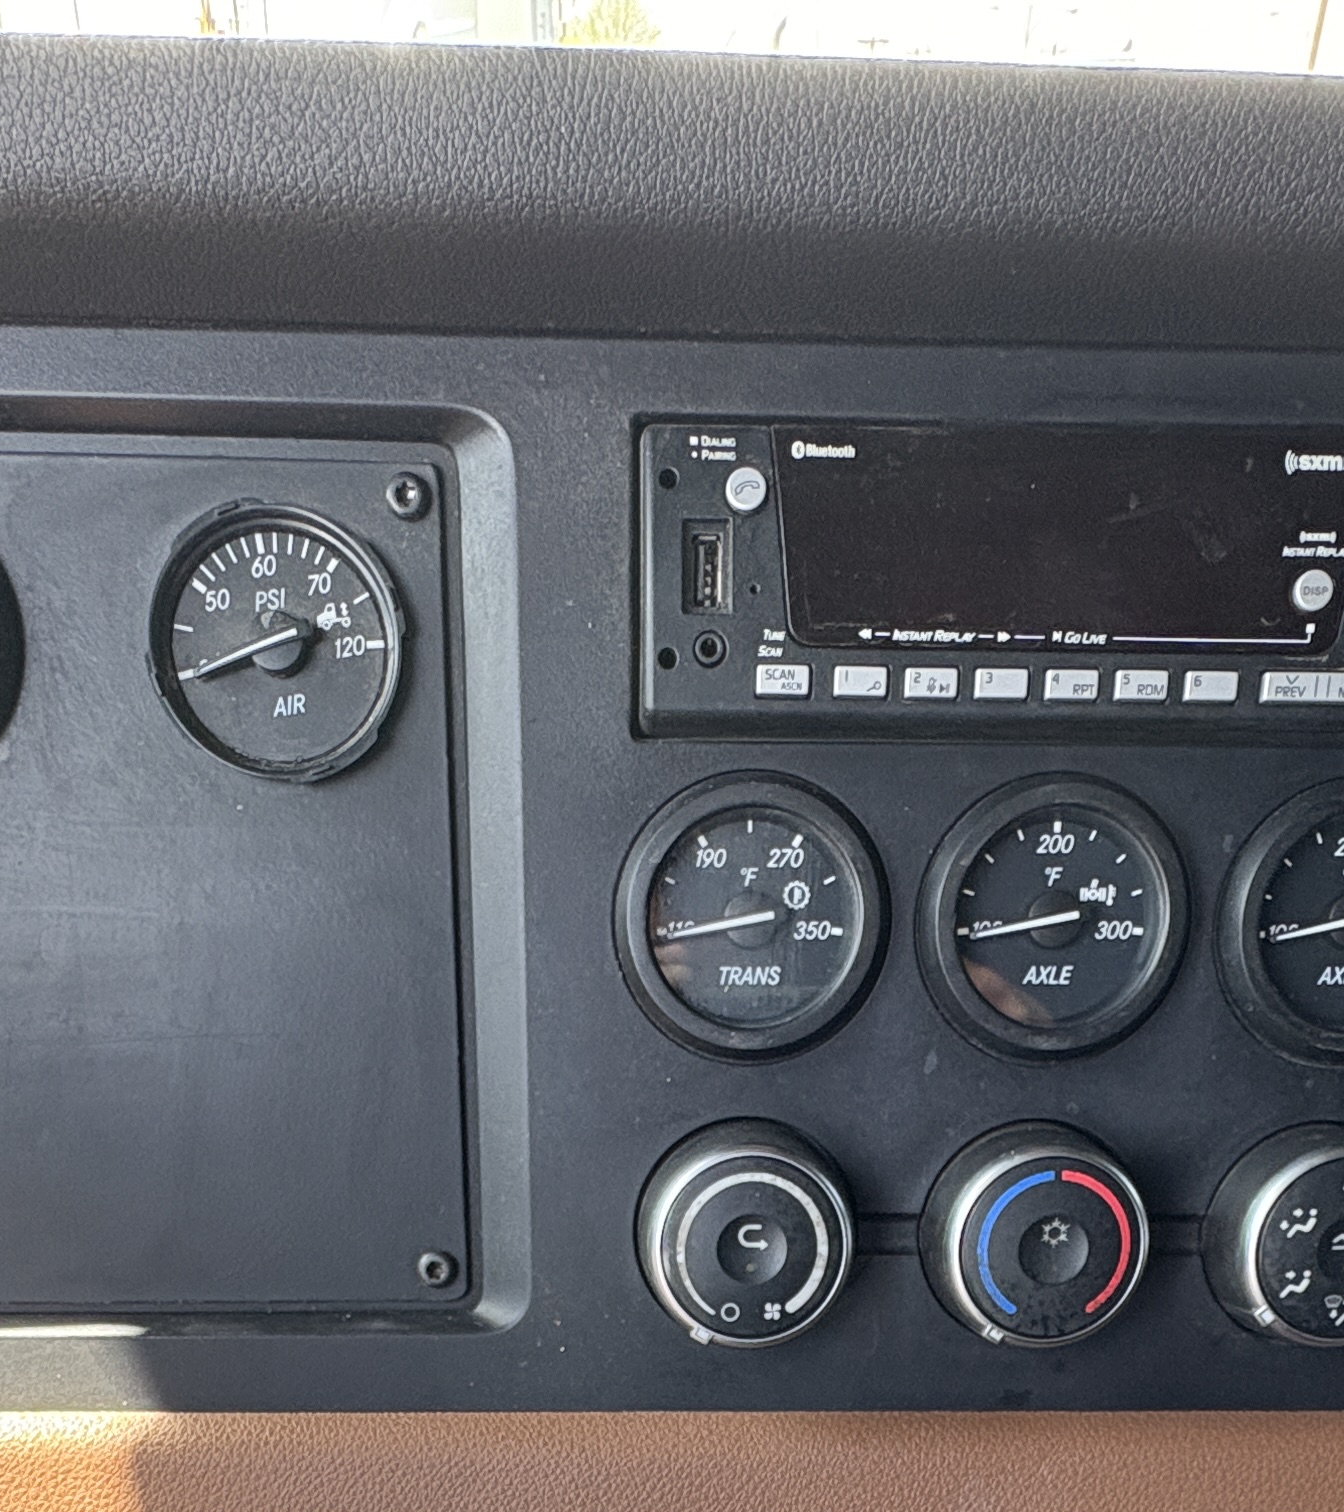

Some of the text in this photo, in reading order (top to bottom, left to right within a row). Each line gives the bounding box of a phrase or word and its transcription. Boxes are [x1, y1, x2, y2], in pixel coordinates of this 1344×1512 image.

[805, 443, 856, 459] Bluetooth
[251, 555, 277, 578] 60
[307, 571, 333, 597] 70
[1302, 585, 1330, 597] DISP
[205, 588, 232, 612] 50
[255, 587, 287, 613] PSI
[933, 629, 977, 643] REPLAY
[334, 634, 366, 660] 120
[757, 645, 784, 658] SCAN
[764, 668, 796, 681] SCAN
[913, 671, 922, 684] 2
[984, 671, 994, 684] 3
[1051, 672, 1060, 686] 4
[1122, 673, 1131, 686] 5
[1193, 674, 1203, 688] 6
[1072, 683, 1095, 696] RPT
[1136, 683, 1165, 697] RDM
[1274, 686, 1307, 698] PREV
[272, 693, 307, 718] AIR
[1035, 833, 1075, 855] 200
[694, 848, 728, 869] 190
[766, 848, 805, 869] 270
[740, 867, 759, 888] °F
[1044, 866, 1064, 888] °F
[793, 920, 832, 941] 350
[1094, 920, 1134, 941] 300
[719, 965, 783, 987] TRANS
[1021, 965, 1075, 986] AXLE
